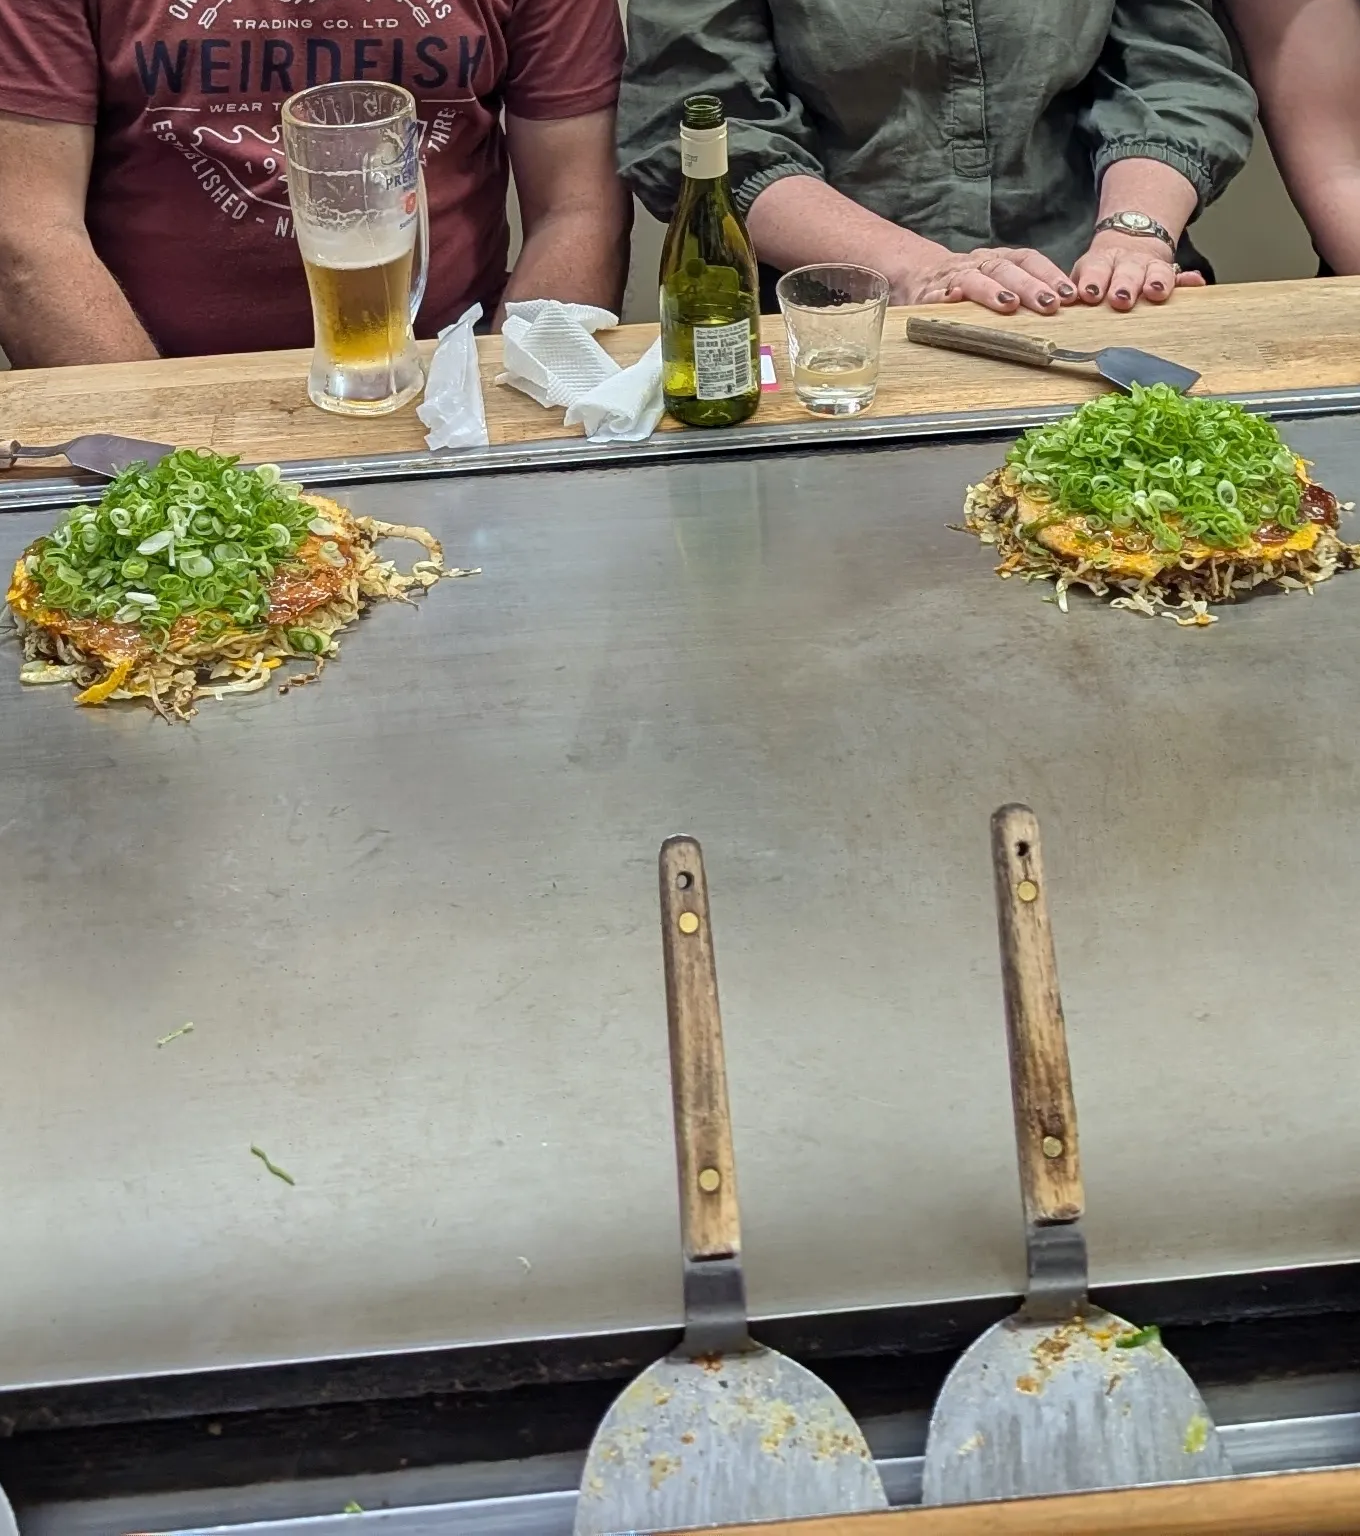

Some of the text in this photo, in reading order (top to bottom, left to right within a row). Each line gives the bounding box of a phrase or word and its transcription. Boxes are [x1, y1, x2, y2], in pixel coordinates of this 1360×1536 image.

[232, 17, 399, 30] TRADING CO. LTD
[209, 101, 263, 114] WEAR
